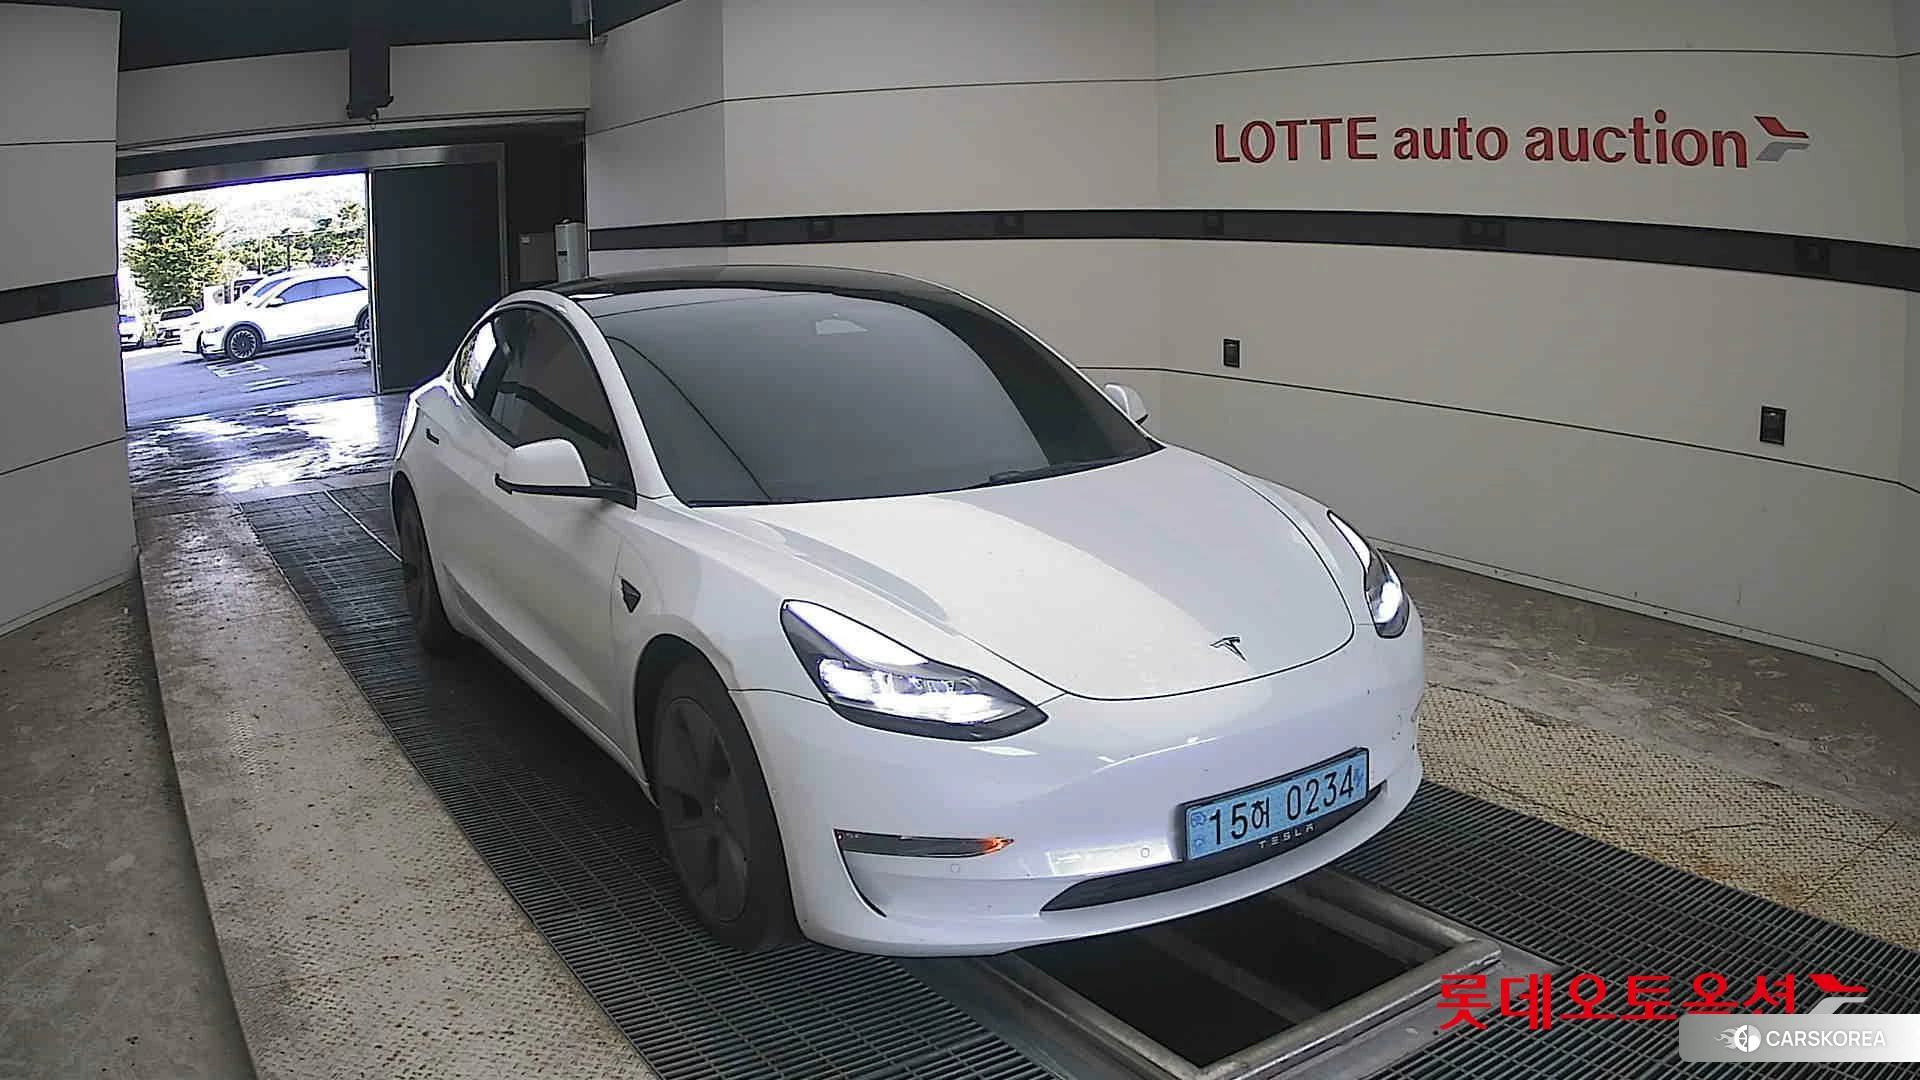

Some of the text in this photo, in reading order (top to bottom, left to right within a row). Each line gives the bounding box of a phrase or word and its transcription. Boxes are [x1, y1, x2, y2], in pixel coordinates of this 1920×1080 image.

[1214, 110, 1749, 169] LOTTE auto auction
[1209, 764, 1355, 845] 15허 0234
[1257, 823, 1316, 850] TESLA
